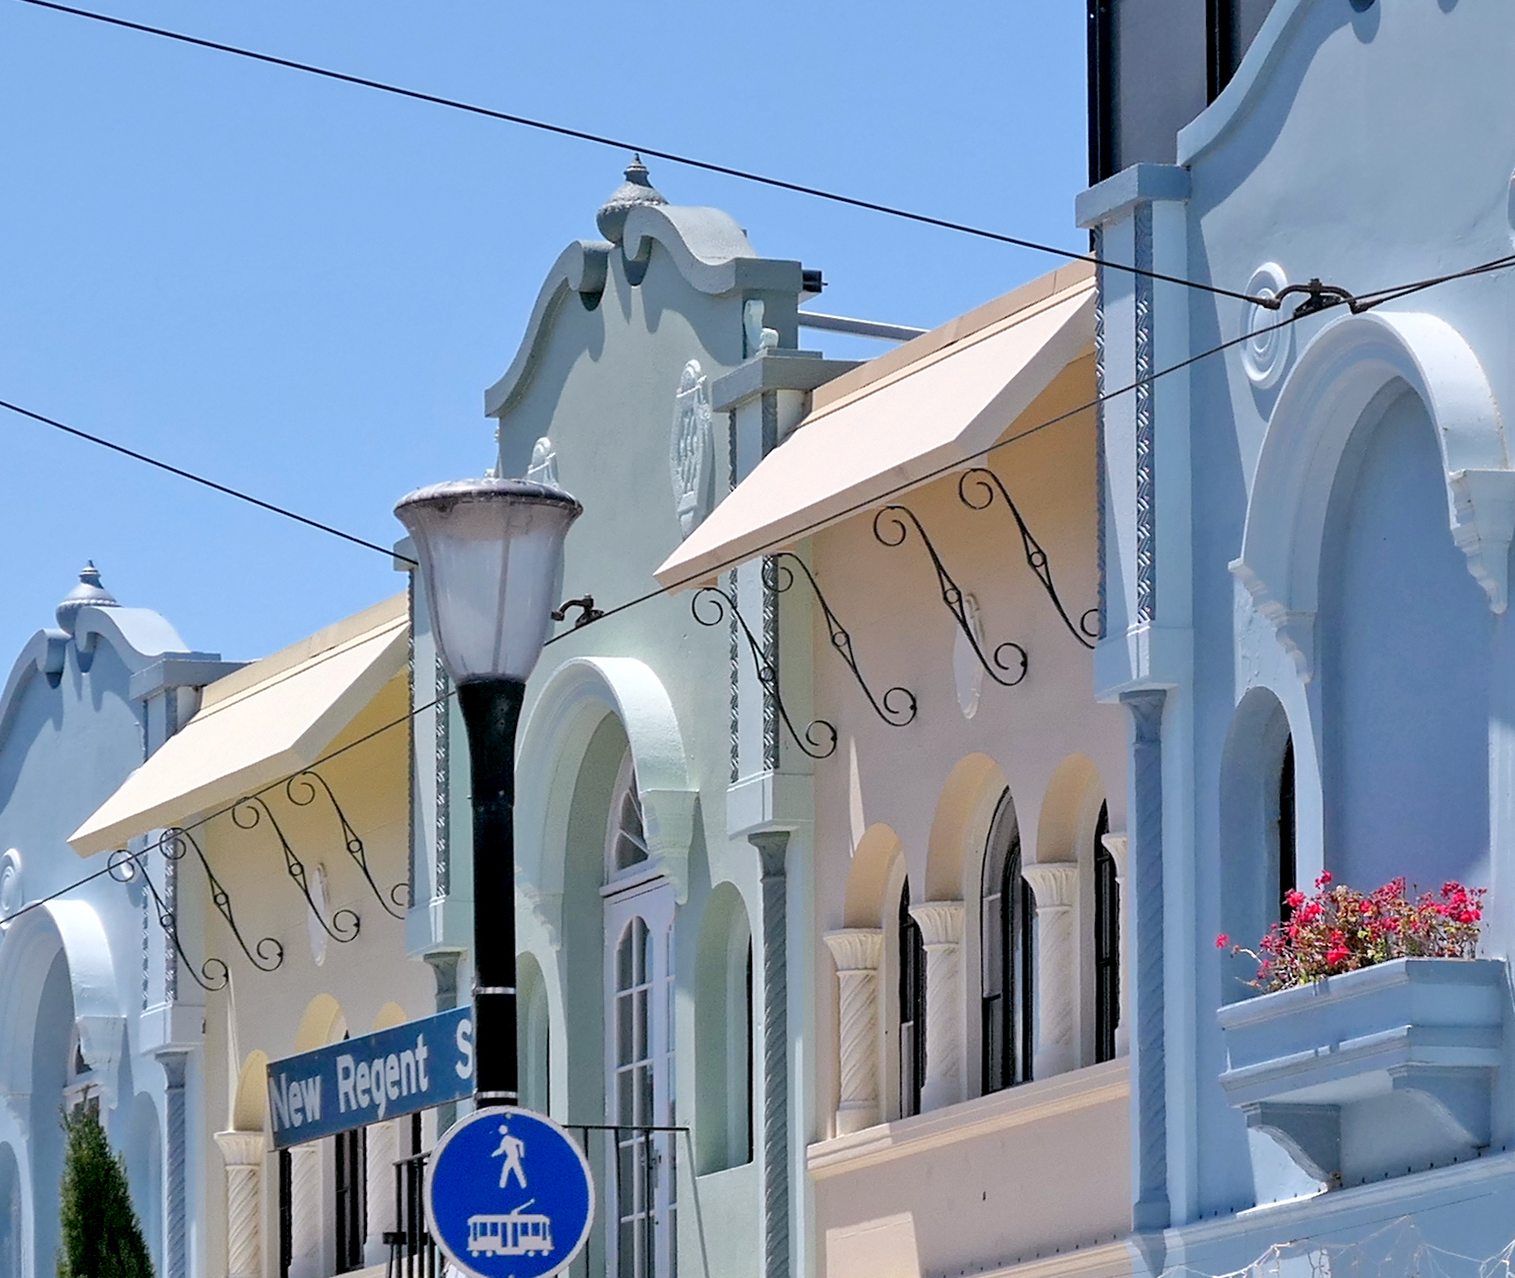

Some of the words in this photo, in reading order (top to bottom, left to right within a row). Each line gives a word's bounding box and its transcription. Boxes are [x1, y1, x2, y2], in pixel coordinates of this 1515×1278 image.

[271, 1070, 321, 1132] New
[336, 1032, 429, 1121] Regent
[454, 1020, 473, 1078] S
